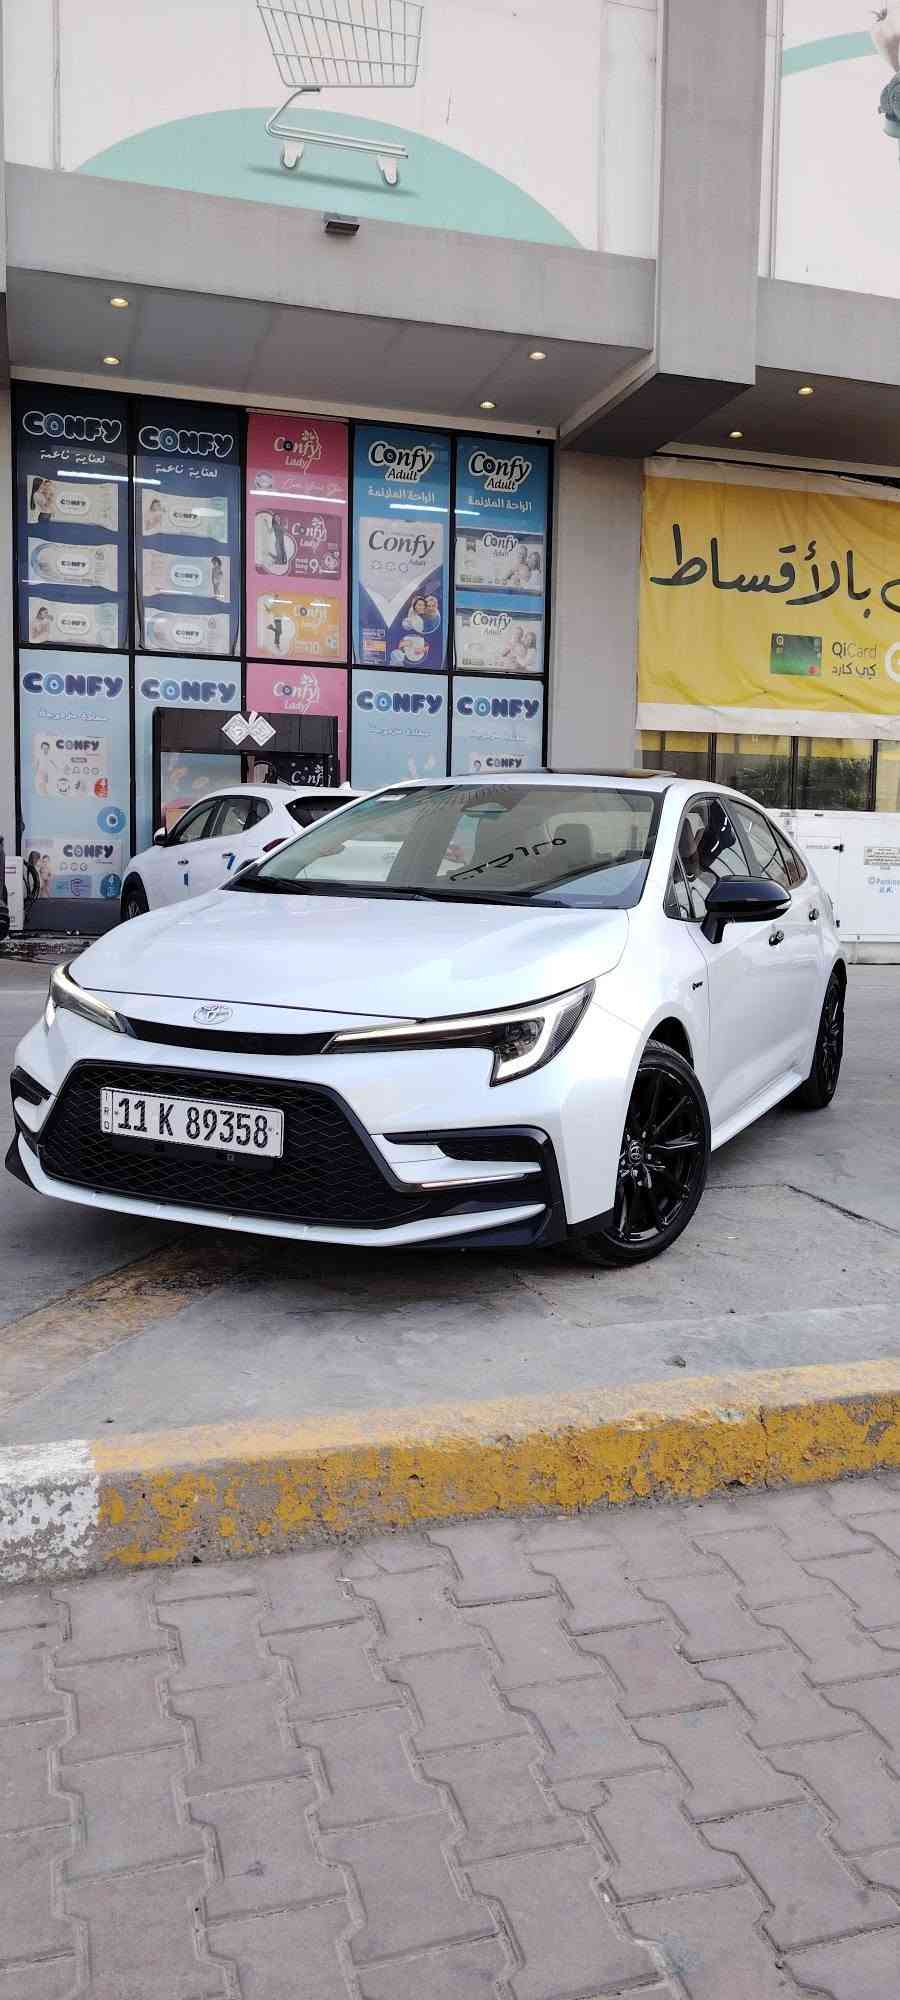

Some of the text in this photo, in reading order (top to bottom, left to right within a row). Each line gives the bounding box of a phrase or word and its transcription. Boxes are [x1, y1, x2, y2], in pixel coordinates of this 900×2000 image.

[23, 411, 121, 443] CONFY
[139, 426, 233, 458] CONFY
[273, 436, 322, 458] Confy
[370, 442, 433, 474] Confy
[470, 452, 531, 482] Confy
[386, 469, 418, 481] Adult
[487, 479, 516, 490] Adult
[61, 499, 86, 507] CONFY
[173, 511, 198, 520] CONFY
[368, 530, 435, 558] Confy
[483, 533, 518, 552] Confy
[61, 560, 86, 568] CONFY
[650, 523, 872, 618] بالأقساط
[174, 571, 199, 579] CONFY
[61, 619, 86, 627] CONFY
[472, 611, 512, 632] Confy
[22, 672, 124, 698] CONFY
[140, 678, 236, 703] CONFY
[273, 682, 320, 702] Confy
[356, 690, 443, 714] CONFY
[457, 696, 540, 719] CONFY
[56, 739, 99, 751] CONFY
[486, 757, 522, 769] CONFY
[63, 844, 114, 858] CONFY
[118, 1098, 268, 1149] 11 K 89358
